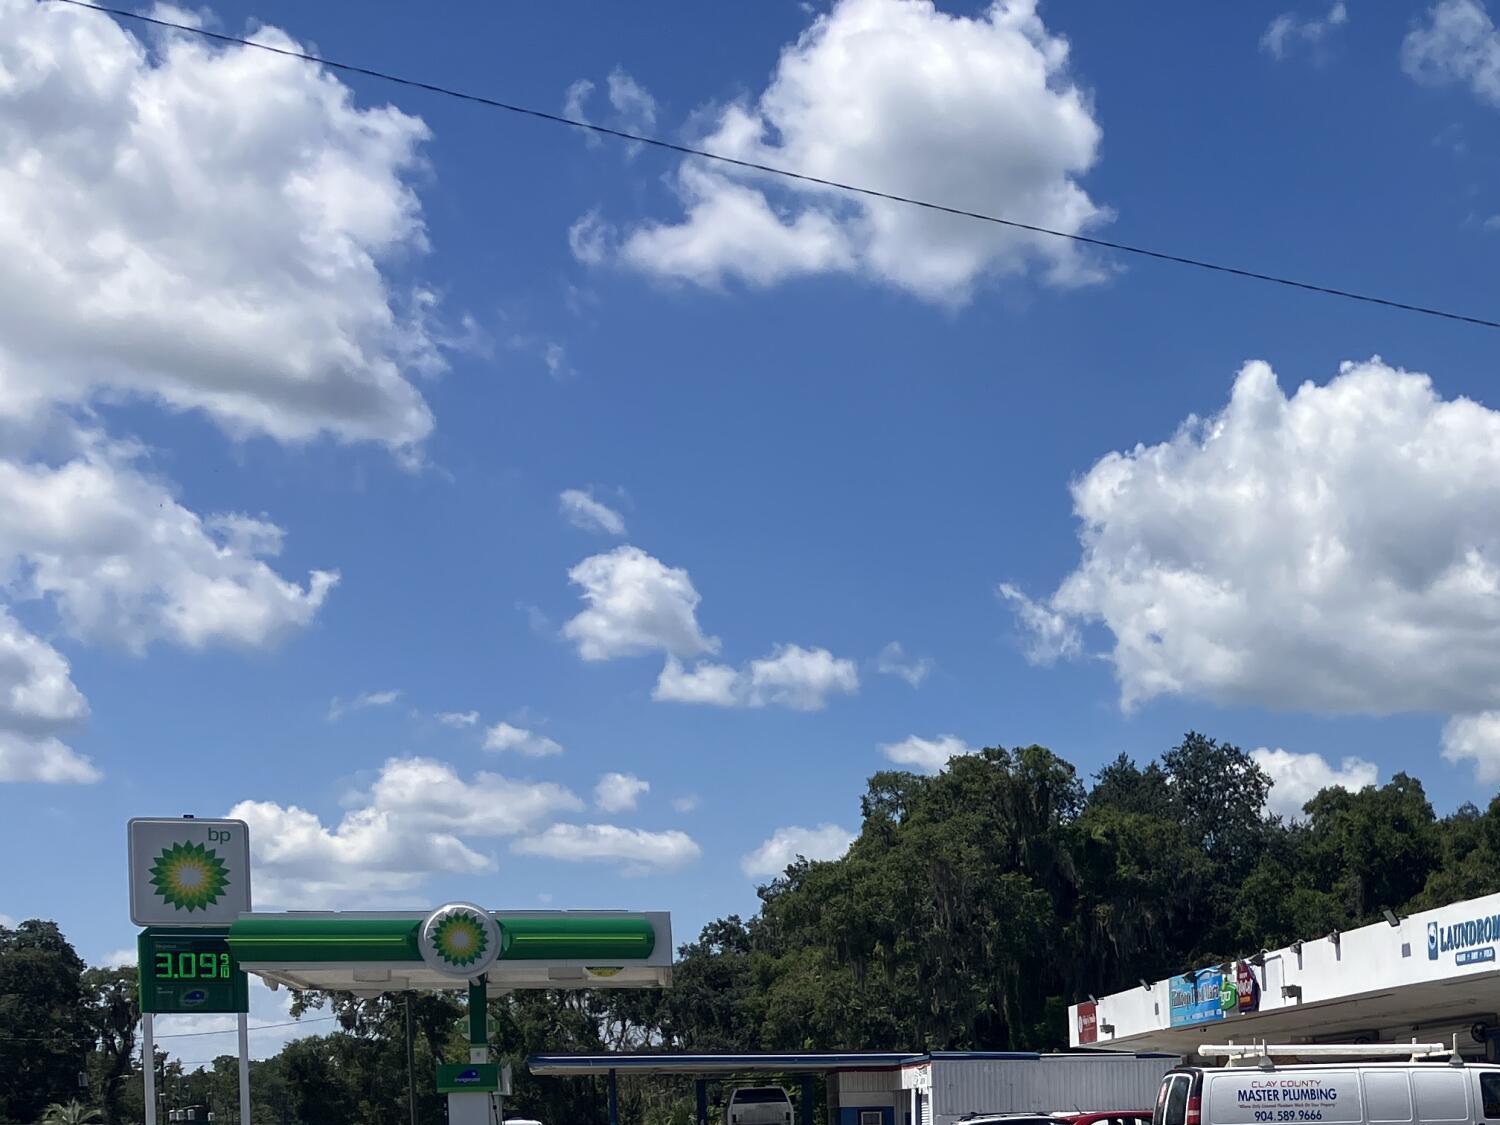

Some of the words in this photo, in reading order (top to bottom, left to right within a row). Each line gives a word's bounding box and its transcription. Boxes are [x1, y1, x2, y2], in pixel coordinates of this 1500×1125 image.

[208, 827, 231, 845] bp
[155, 952, 217, 978] 3.09
[1251, 1081, 1277, 1089] CLAY
[1280, 1080, 1322, 1088] COUNTY
[1237, 1089, 1280, 1102] MASTER
[1283, 1088, 1337, 1101] PLUMBING
[1254, 1110, 1323, 1122] 904.589.9666
